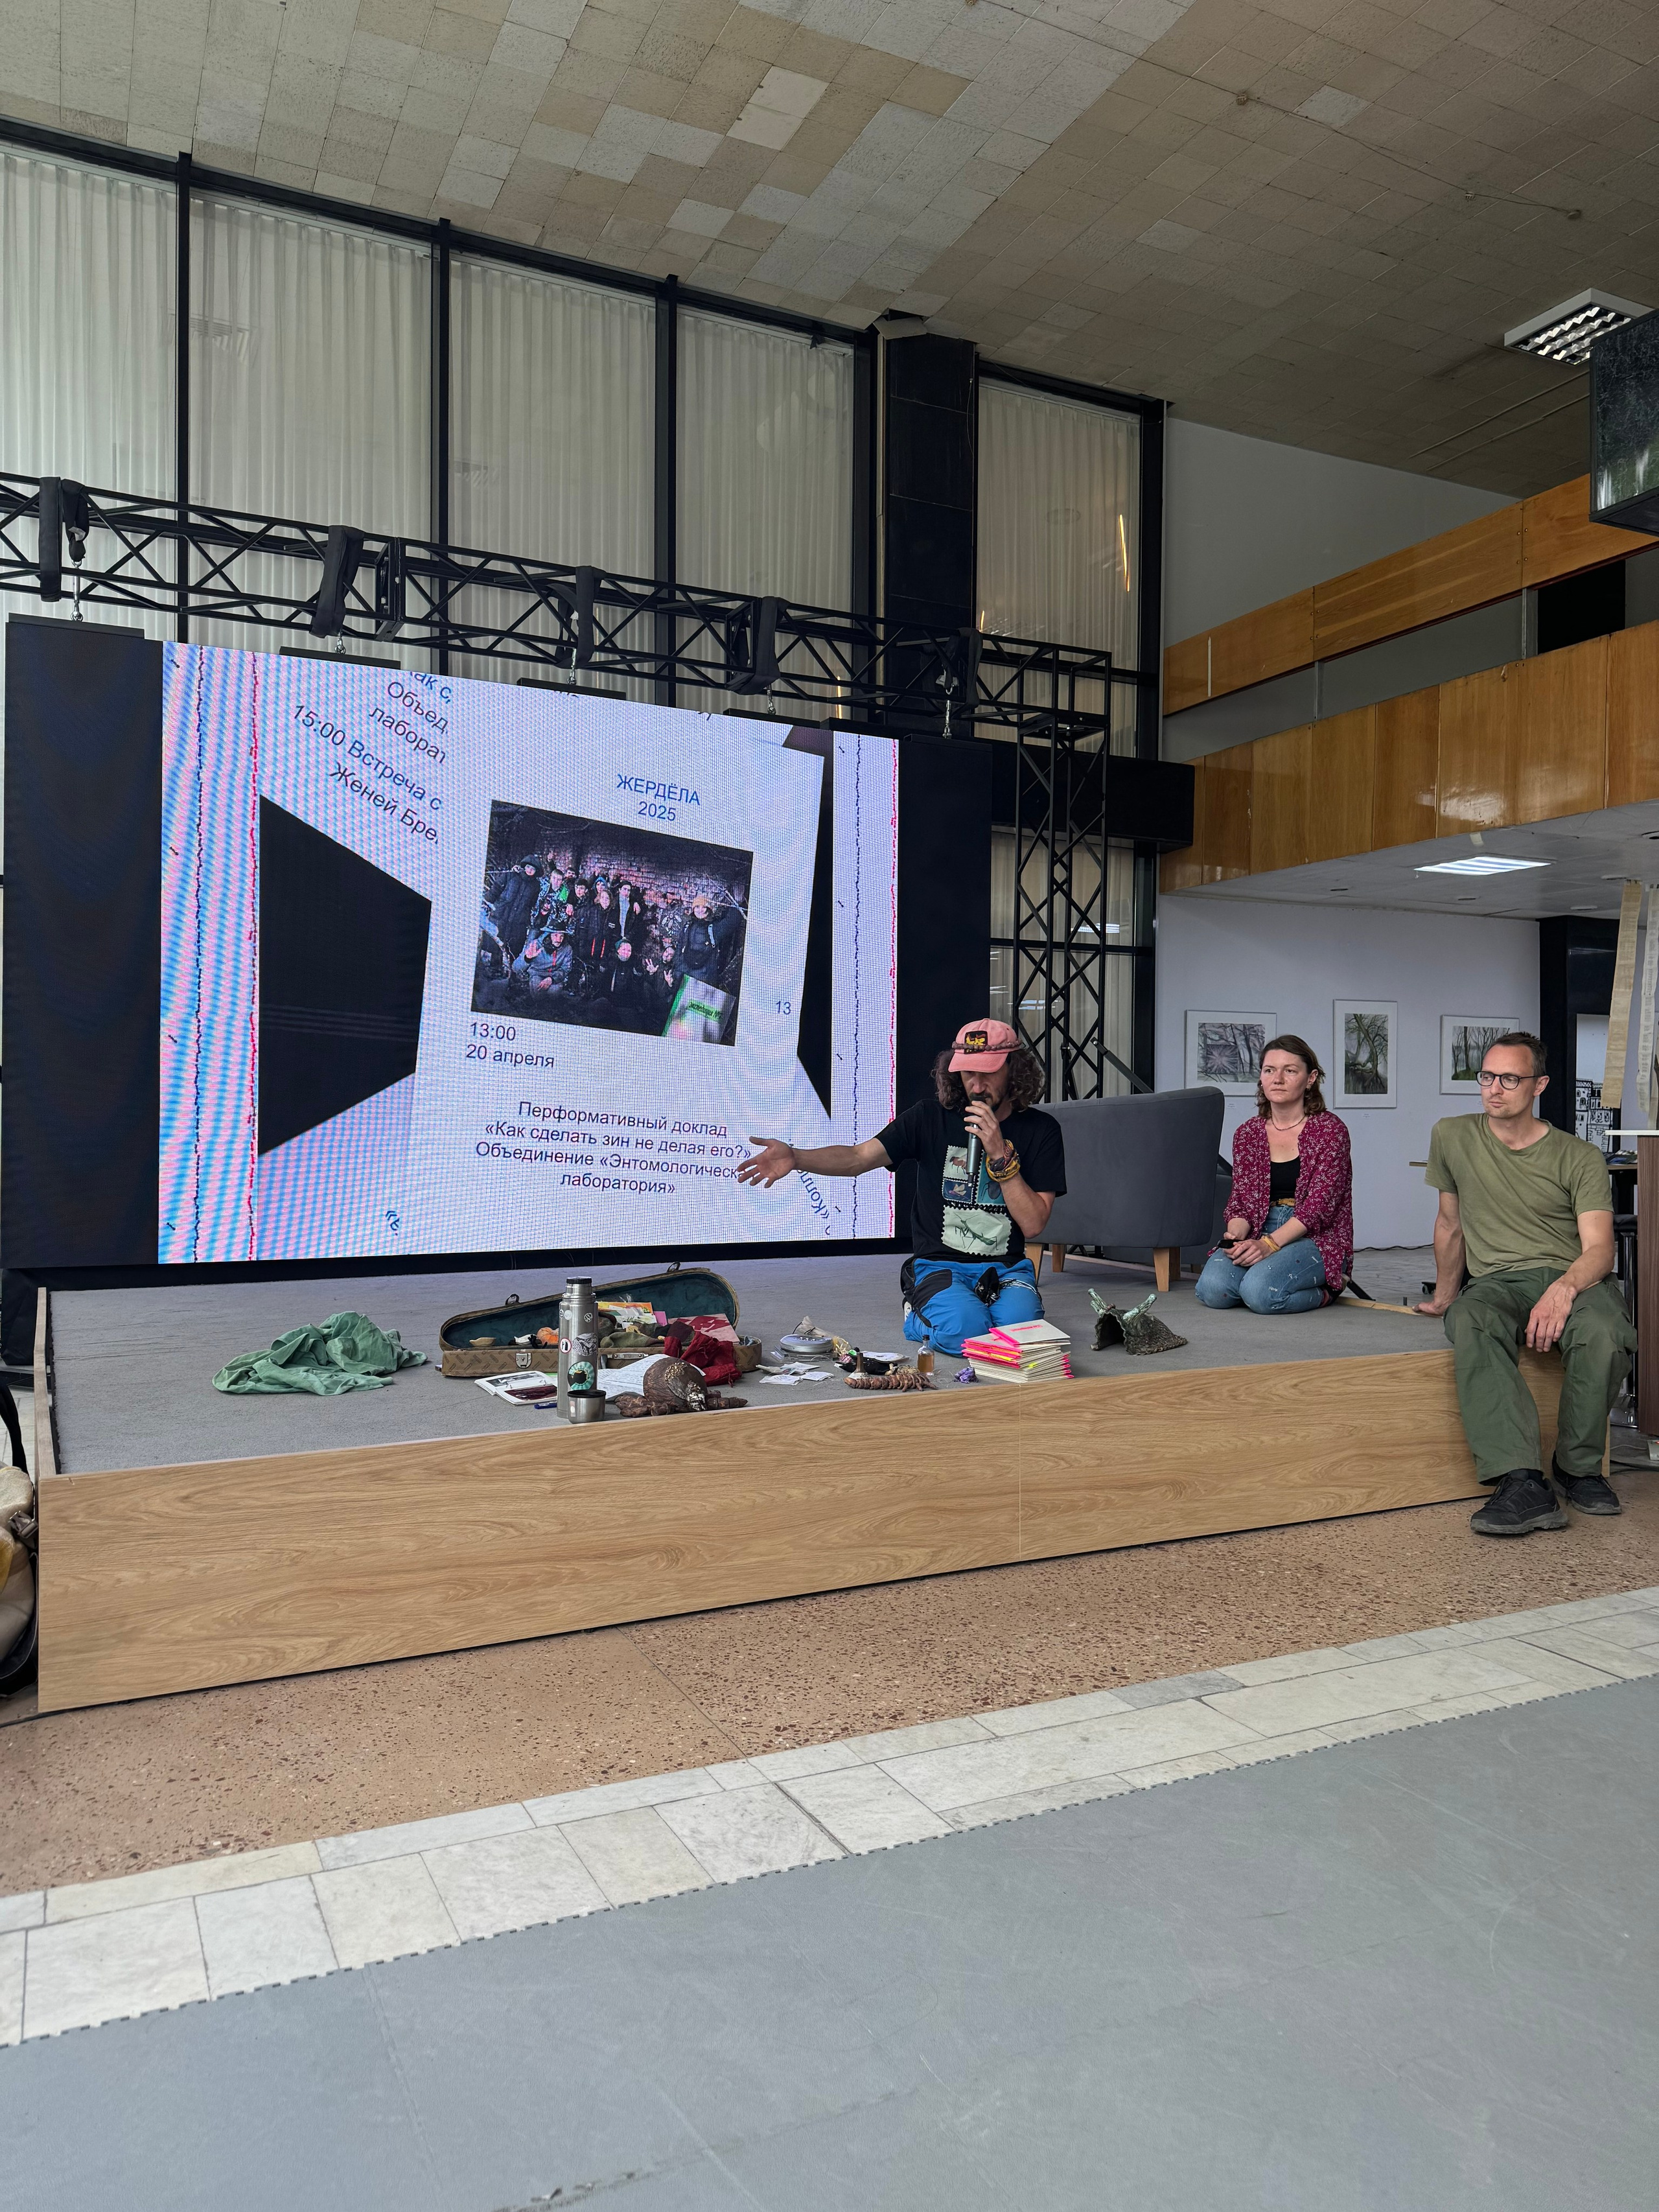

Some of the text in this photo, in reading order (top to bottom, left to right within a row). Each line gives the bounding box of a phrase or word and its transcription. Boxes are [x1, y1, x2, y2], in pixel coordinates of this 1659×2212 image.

[410, 671, 437, 690] ак
[294, 705, 441, 809] 15:00 Встреча с
[329, 762, 438, 844] Женей Бре
[616, 773, 701, 806] ЖЕРДЁЛА
[638, 801, 677, 821] 2025
[776, 1001, 791, 1015] 13
[470, 1021, 516, 1041] 13:00
[466, 1044, 555, 1068] 20 апреля
[518, 1101, 727, 1137] Перформативный доклад
[485, 1121, 751, 1159] «Как сделать зин не делая его?»
[476, 1141, 745, 1178] Объединение «Энтомологическ
[560, 1173, 675, 1194] лаборатория»
